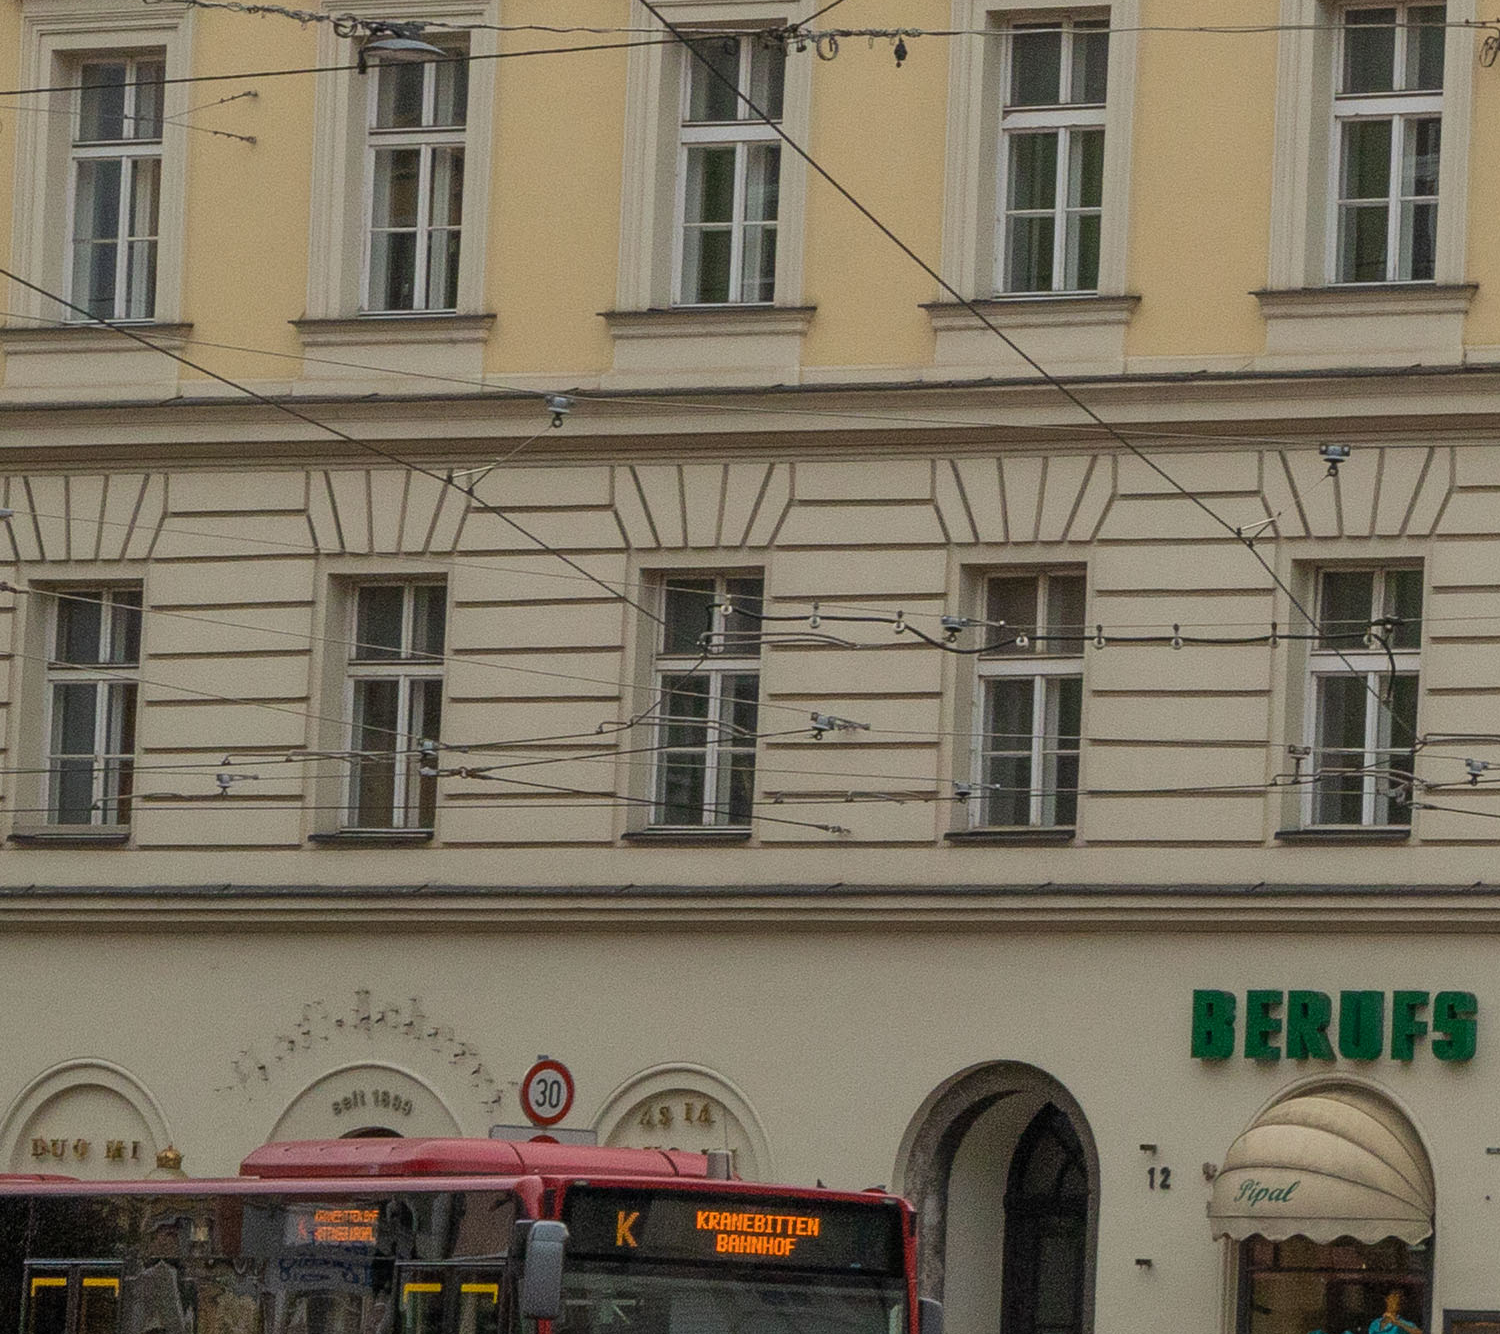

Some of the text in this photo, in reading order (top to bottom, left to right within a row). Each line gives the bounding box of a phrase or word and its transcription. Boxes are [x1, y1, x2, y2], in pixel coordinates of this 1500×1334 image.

[1191, 989, 1478, 1065] BERUFS
[534, 1078, 562, 1109] 30
[1146, 1164, 1172, 1190] 12
[1233, 1178, 1302, 1209] Pipal
[616, 1211, 640, 1247] K
[697, 1211, 820, 1237] KRANEBITTEN
[716, 1234, 797, 1258] BAHNHOF
